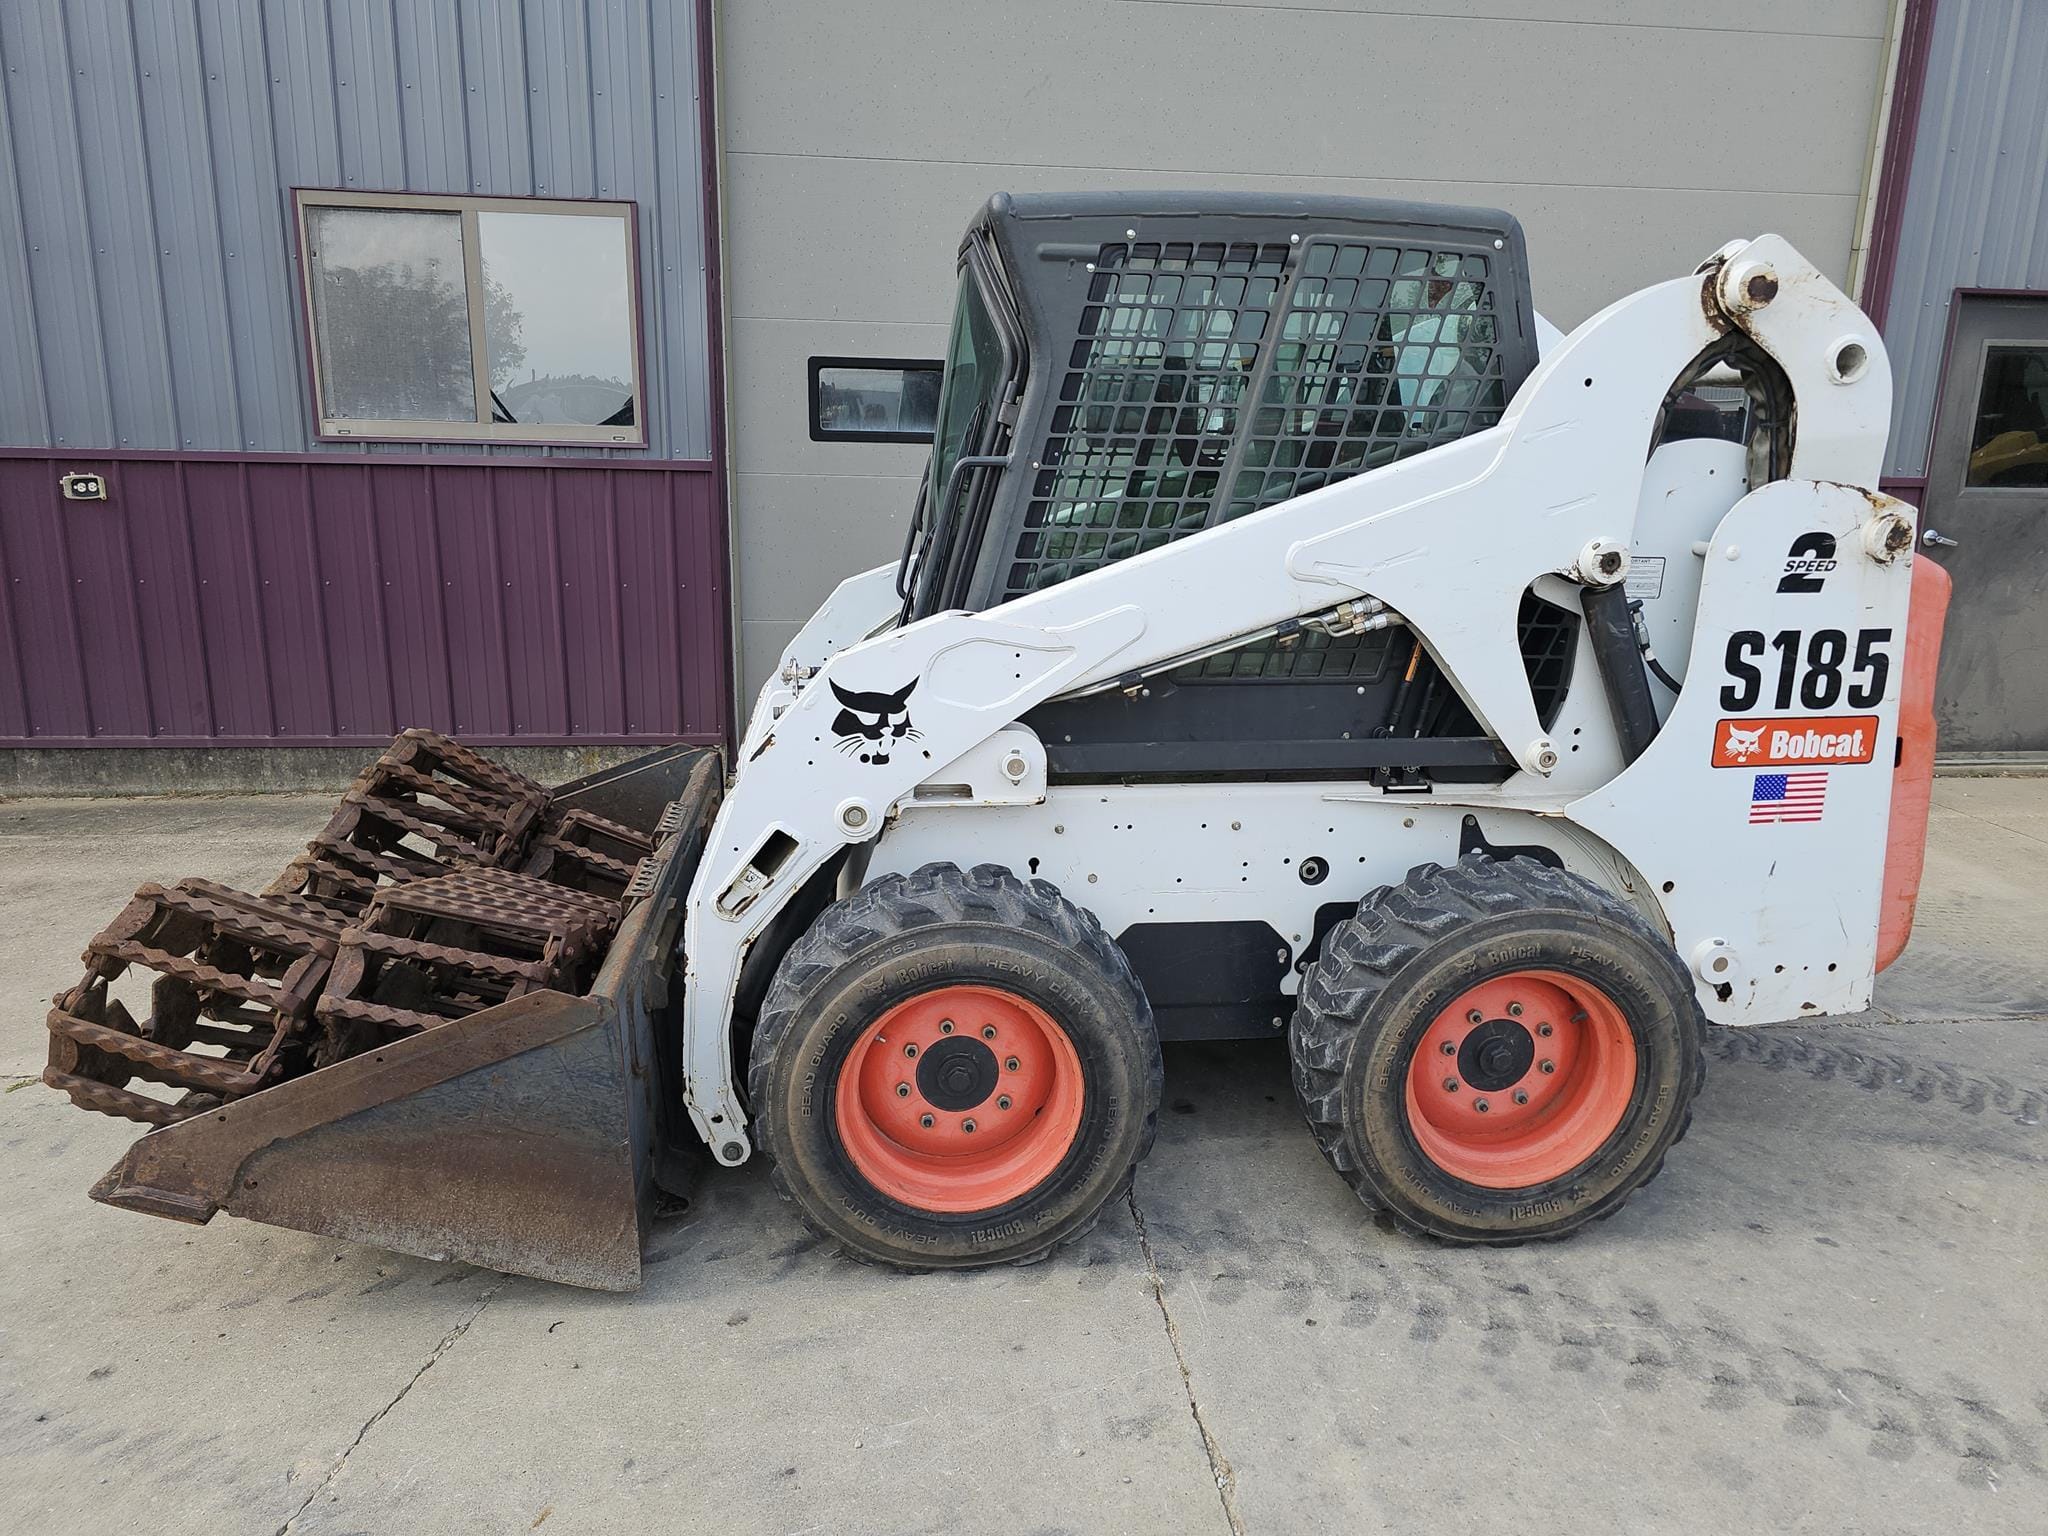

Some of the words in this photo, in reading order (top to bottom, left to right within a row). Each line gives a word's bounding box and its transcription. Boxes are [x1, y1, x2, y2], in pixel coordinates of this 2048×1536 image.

[1776, 532, 1836, 593] 2
[1783, 560, 1837, 572] SPEED
[1720, 628, 1892, 712] S185
[1769, 729, 1863, 759] Bobcat
[896, 958, 955, 985] Bobcat
[1488, 943, 1542, 965] Bobcat
[986, 959, 1045, 985] HEAVY
[1048, 981, 1089, 1015] DUTY
[1569, 946, 1623, 971] HEAVY
[1624, 973, 1656, 1006] DUTY
[1379, 1045, 1398, 1088] BEAD
[1396, 990, 1438, 1039] GUARD
[801, 1072, 816, 1117] BEAD
[810, 1012, 848, 1067] GUARD
[1648, 1084, 1669, 1127] BEAD
[1610, 1130, 1650, 1177] GUARD
[1435, 1196, 1483, 1218] HEAVY
[1510, 1199, 1564, 1222] Bobcat
[970, 1218, 1026, 1244] Bobcat
